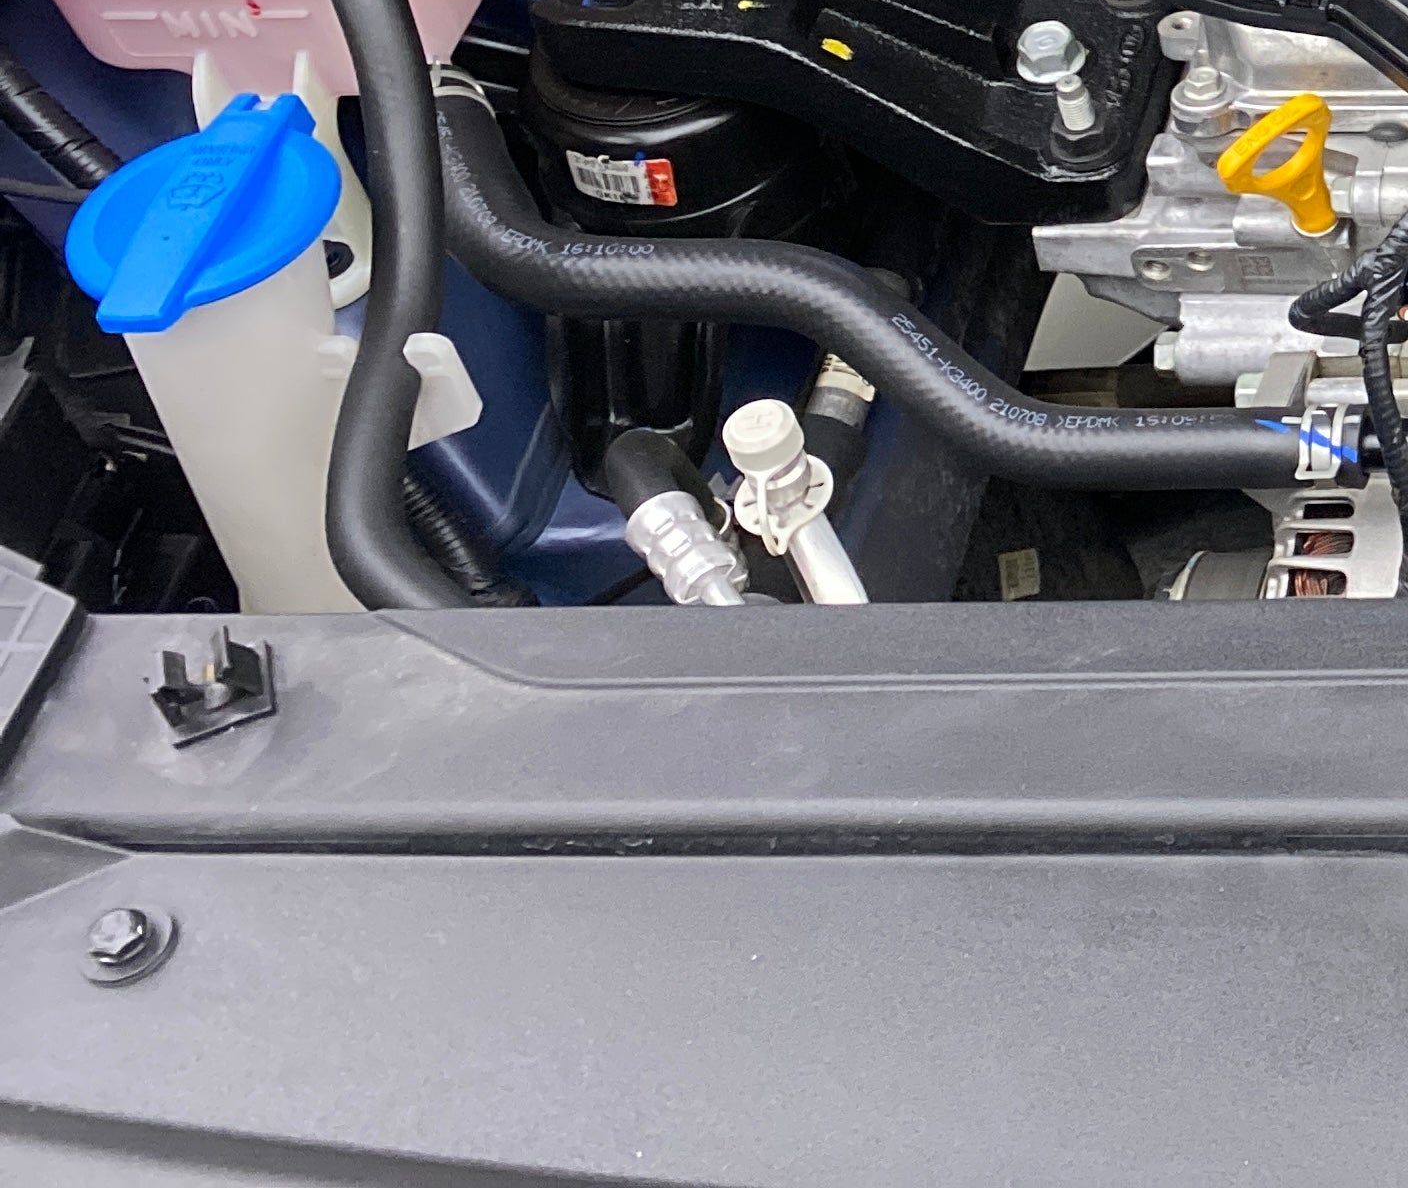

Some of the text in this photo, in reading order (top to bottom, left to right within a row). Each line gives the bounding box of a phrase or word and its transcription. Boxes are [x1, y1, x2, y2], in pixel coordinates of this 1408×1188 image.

[160, 11, 257, 38] MIN
[559, 241, 656, 257] 16:10:00
[891, 313, 988, 402] 25451-K3400
[988, 397, 1048, 428] 210708
